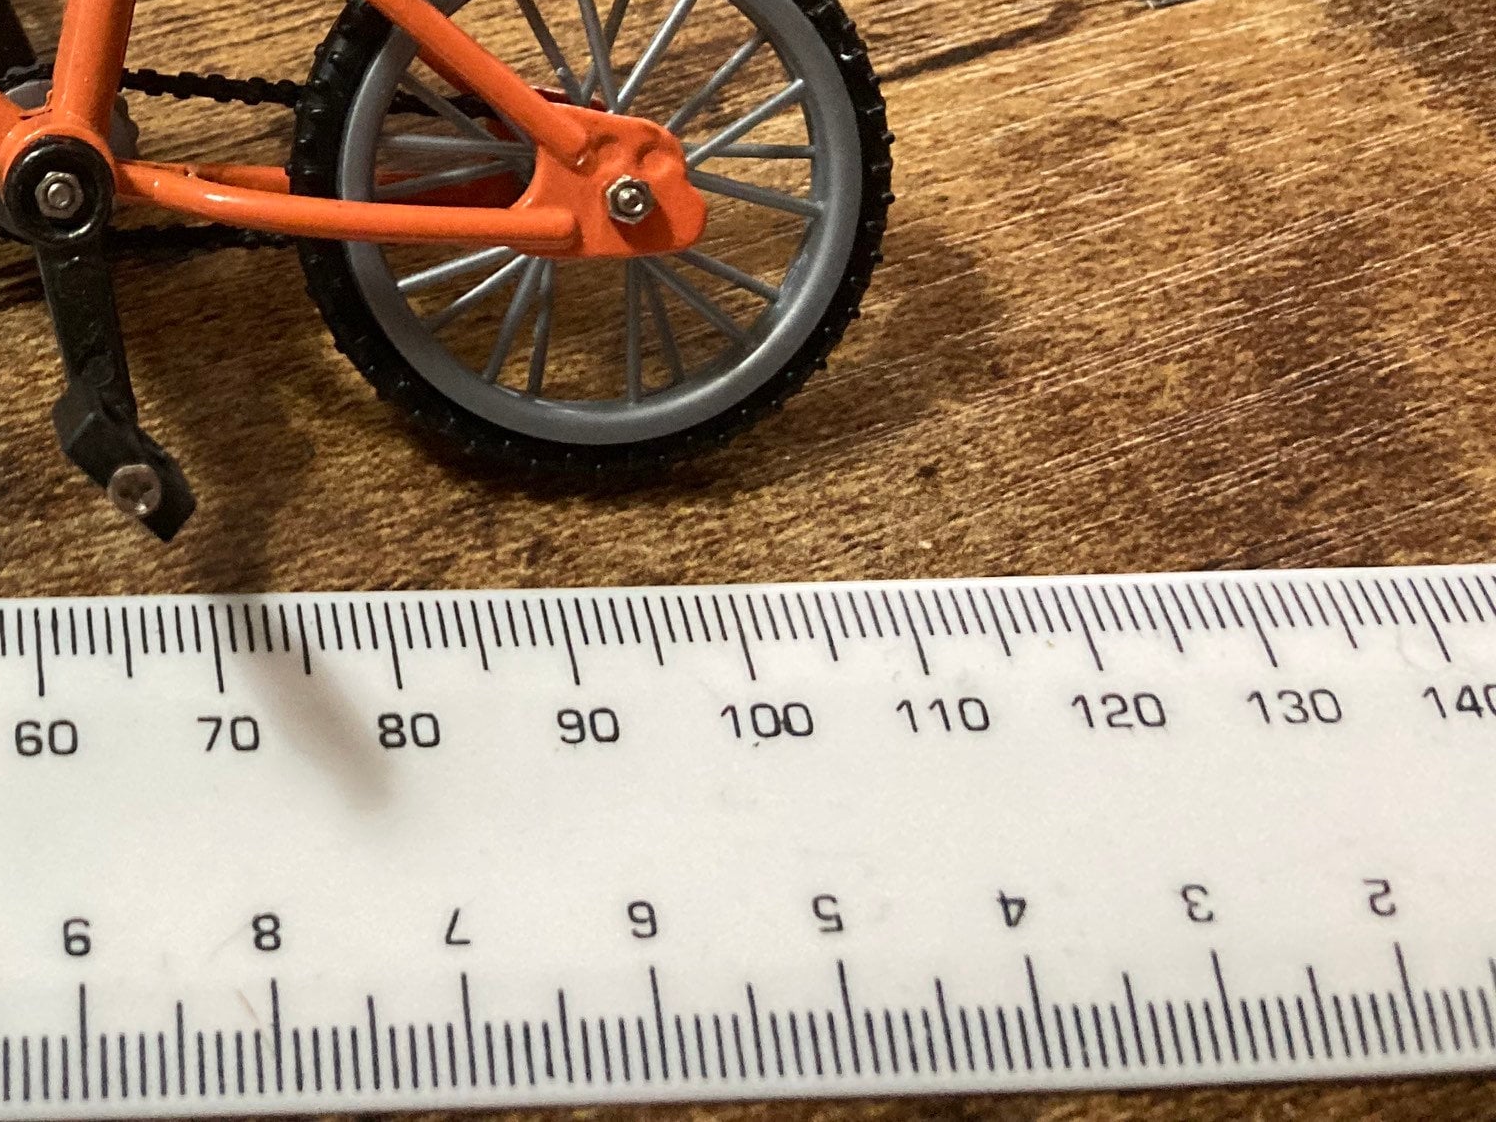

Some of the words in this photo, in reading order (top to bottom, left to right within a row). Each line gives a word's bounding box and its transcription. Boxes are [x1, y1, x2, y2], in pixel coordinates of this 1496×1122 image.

[15, 719, 78, 758] 60
[197, 715, 260, 752] 70
[378, 713, 440, 750] 80
[557, 707, 620, 748] 90
[720, 702, 814, 739] 100
[896, 697, 990, 733] 110
[1071, 690, 1166, 729] 120
[1247, 687, 1343, 726] 130
[812, 894, 844, 934] 5
[996, 890, 1027, 928] 4
[1178, 884, 1217, 924] 3
[1363, 879, 1397, 918] 2
[63, 917, 91, 958] 9
[251, 912, 281, 952] 8
[444, 907, 471, 947] 7
[627, 900, 658, 940] 6
